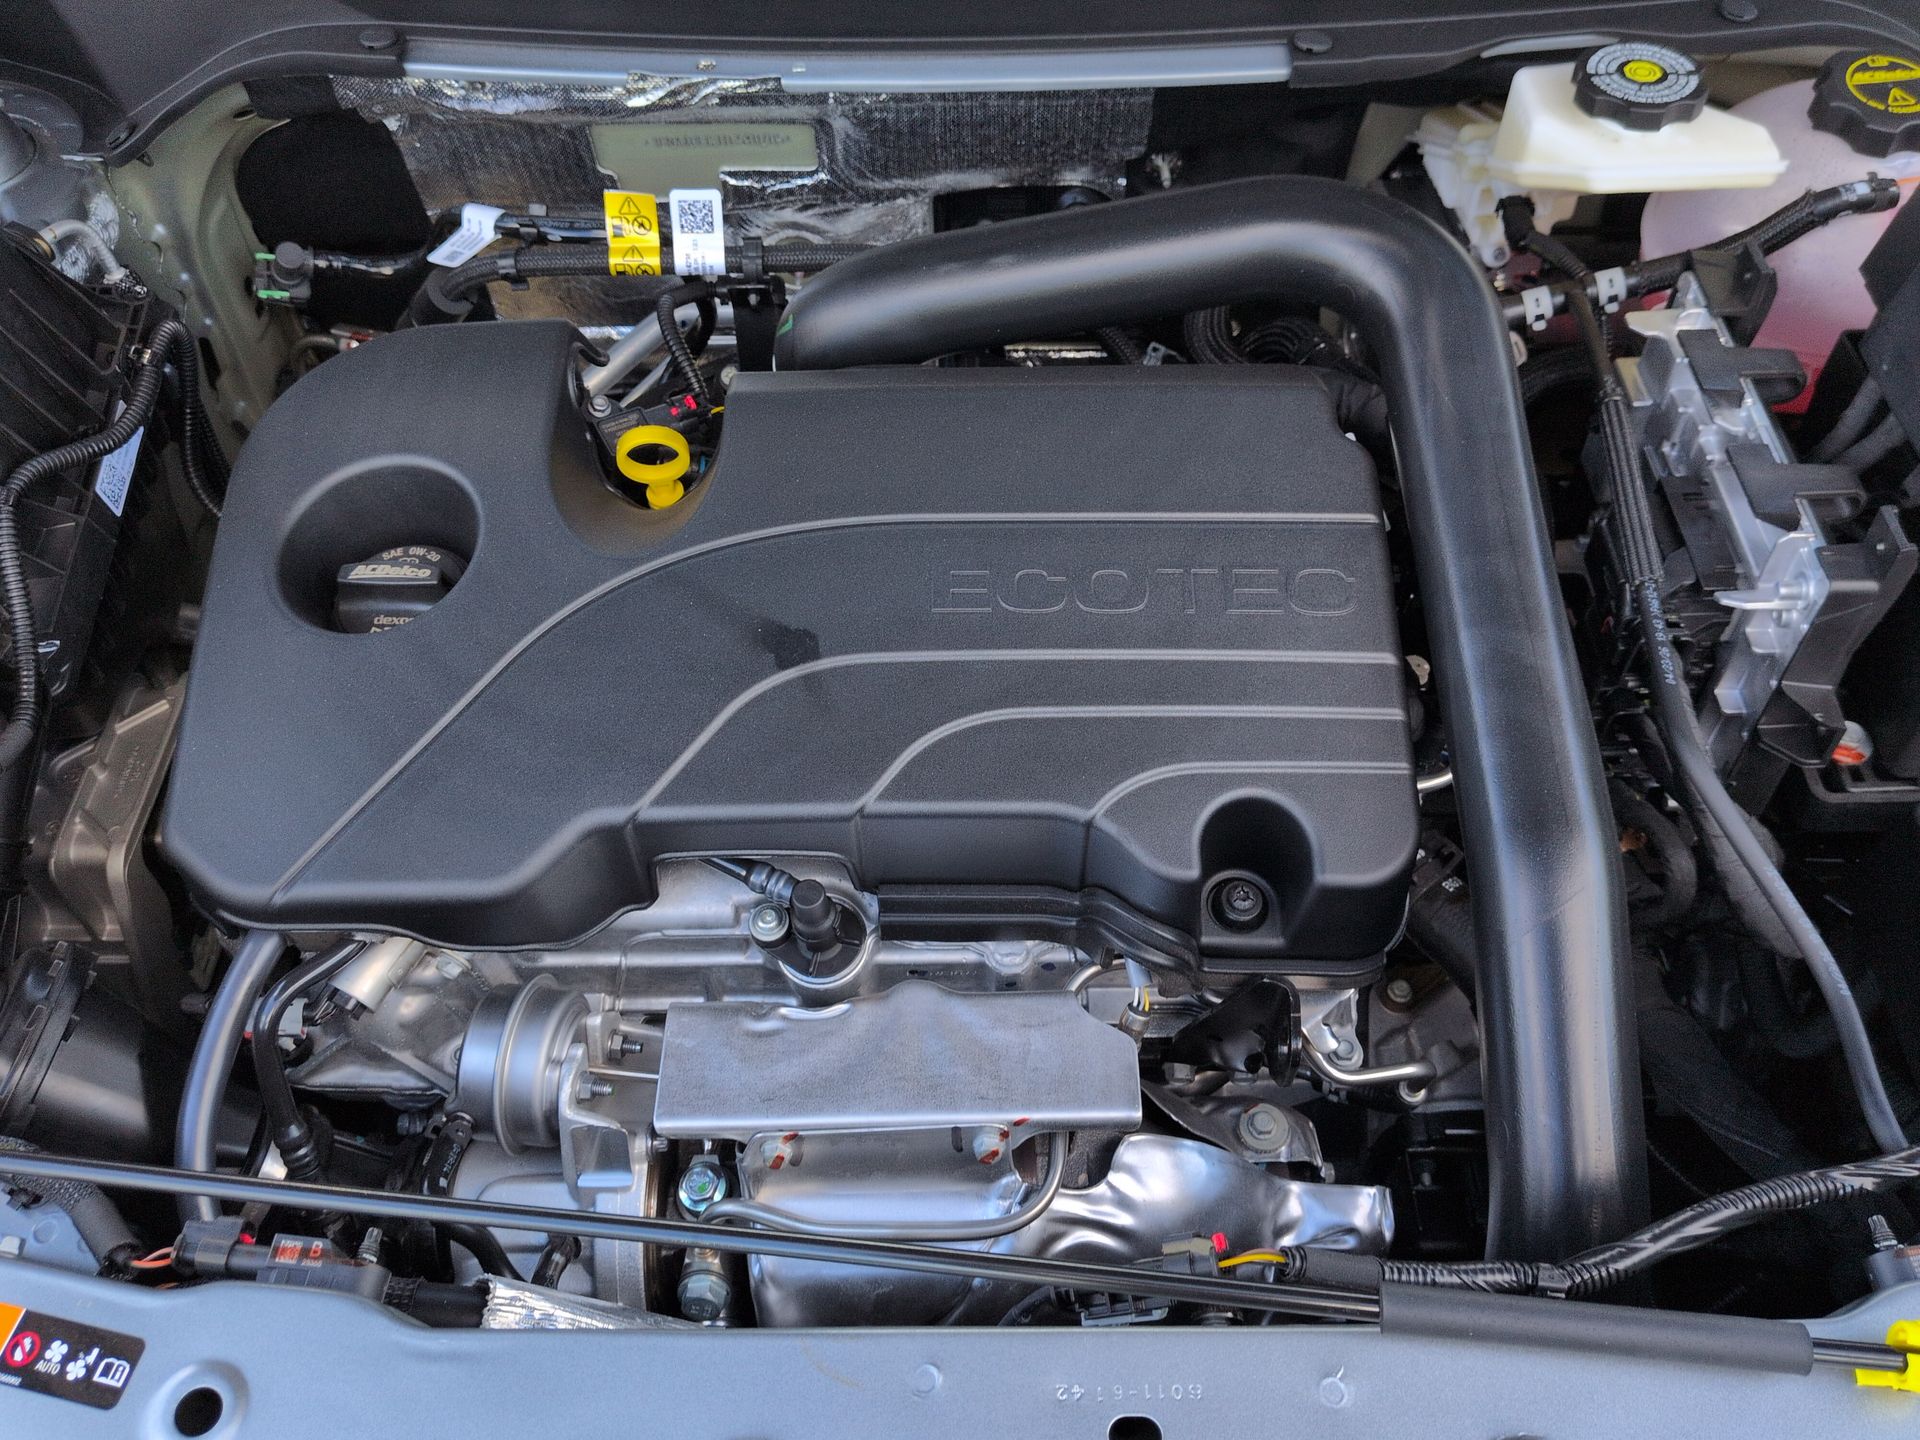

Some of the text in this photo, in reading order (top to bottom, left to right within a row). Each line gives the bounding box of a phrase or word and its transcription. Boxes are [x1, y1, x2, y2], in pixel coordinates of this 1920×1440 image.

[382, 546, 442, 562] SAE 0W-20
[348, 564, 432, 579] ACDelco
[931, 568, 1357, 616] ECOTEC
[373, 614, 415, 625] dexo
[308, 1240, 323, 1258] B
[34, 1359, 61, 1376] AUTO
